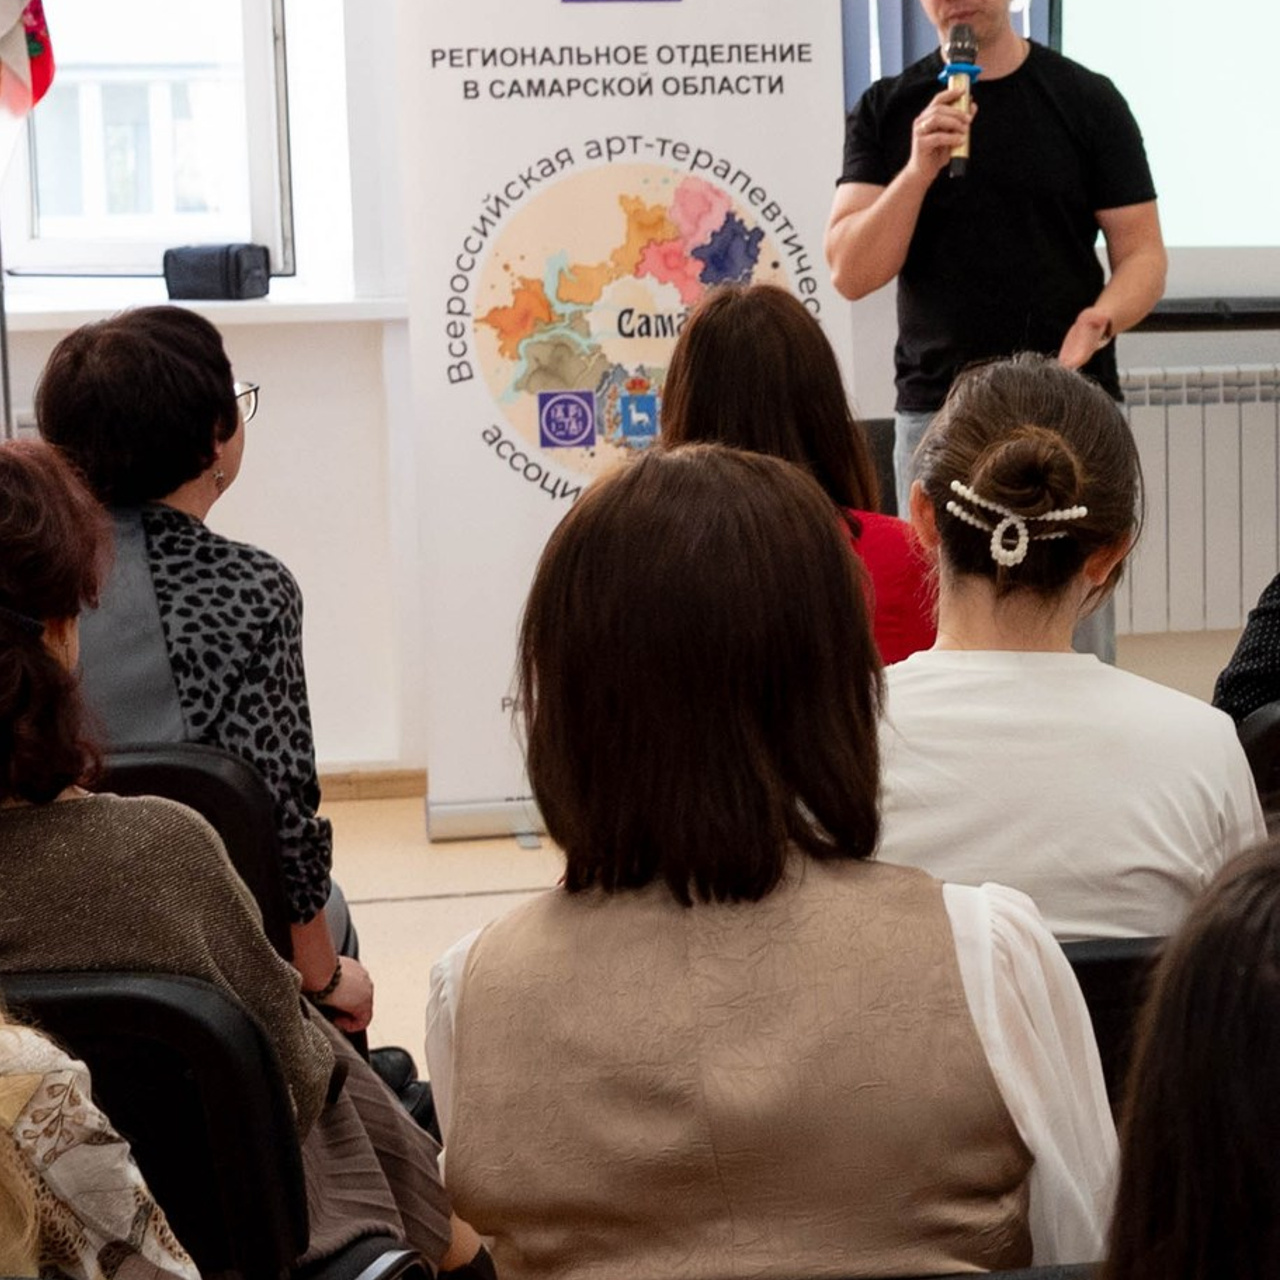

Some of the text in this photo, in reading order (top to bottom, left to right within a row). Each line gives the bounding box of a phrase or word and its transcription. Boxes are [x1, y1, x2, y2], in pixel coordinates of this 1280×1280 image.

[430, 43, 813, 68] РЕГИОНАЛЬНОЕ ОТДЕЛЕНИЕ
[463, 72, 785, 100] В САМАРСКОЙ ОБЛАСТИ
[446, 133, 821, 386] Всероссийская арт-терапевтичес
[616, 307, 689, 340] Сама
[481, 424, 582, 502] ассоци
